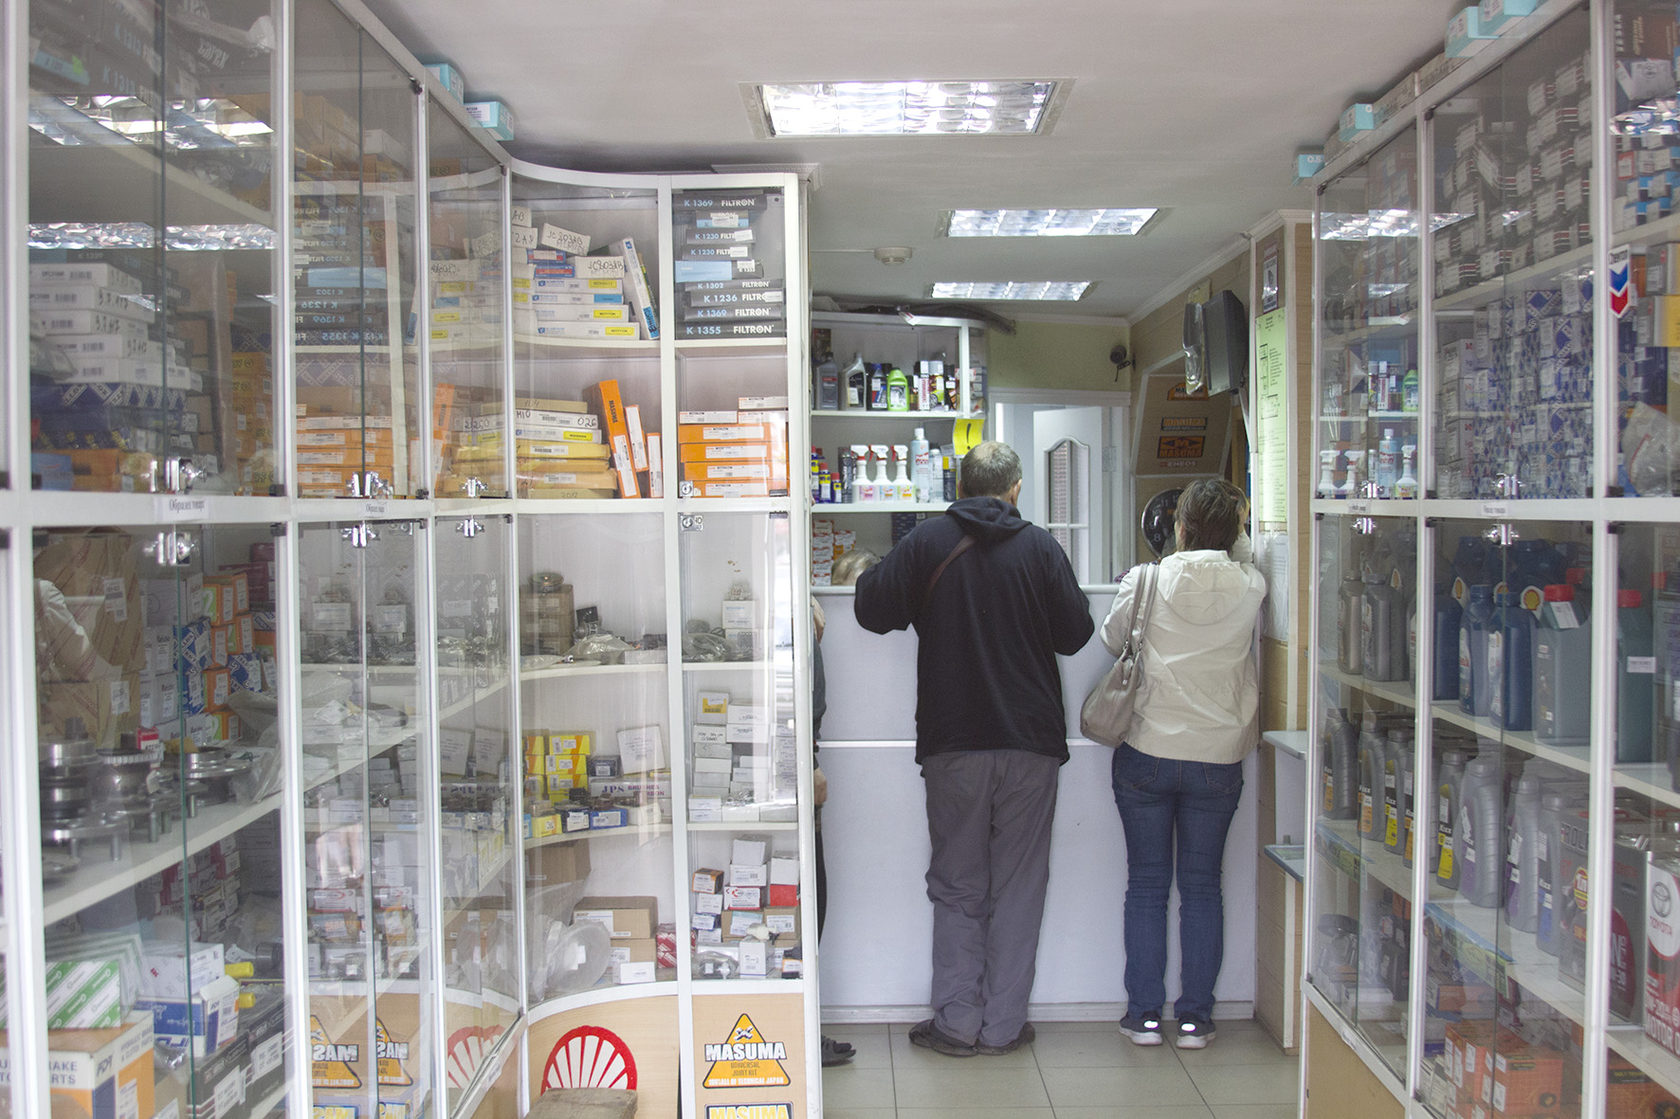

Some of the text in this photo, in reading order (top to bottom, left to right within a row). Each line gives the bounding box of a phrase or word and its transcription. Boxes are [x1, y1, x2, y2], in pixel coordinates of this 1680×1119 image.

[721, 199, 755, 207] FILTRON
[704, 295, 711, 303] K
[713, 294, 738, 302] 1236
[735, 309, 769, 317] FILTRON
[686, 325, 772, 335] K 1355 FILTRON
[602, 785, 625, 794] JPS
[1386, 796, 1397, 805] Kixx
[1439, 823, 1452, 833] Kixx
[1539, 878, 1552, 890] Kixx
[1649, 915, 1673, 936] TOYOTA
[705, 1042, 787, 1062] MASUMA
[51, 1074, 76, 1085] RTS
